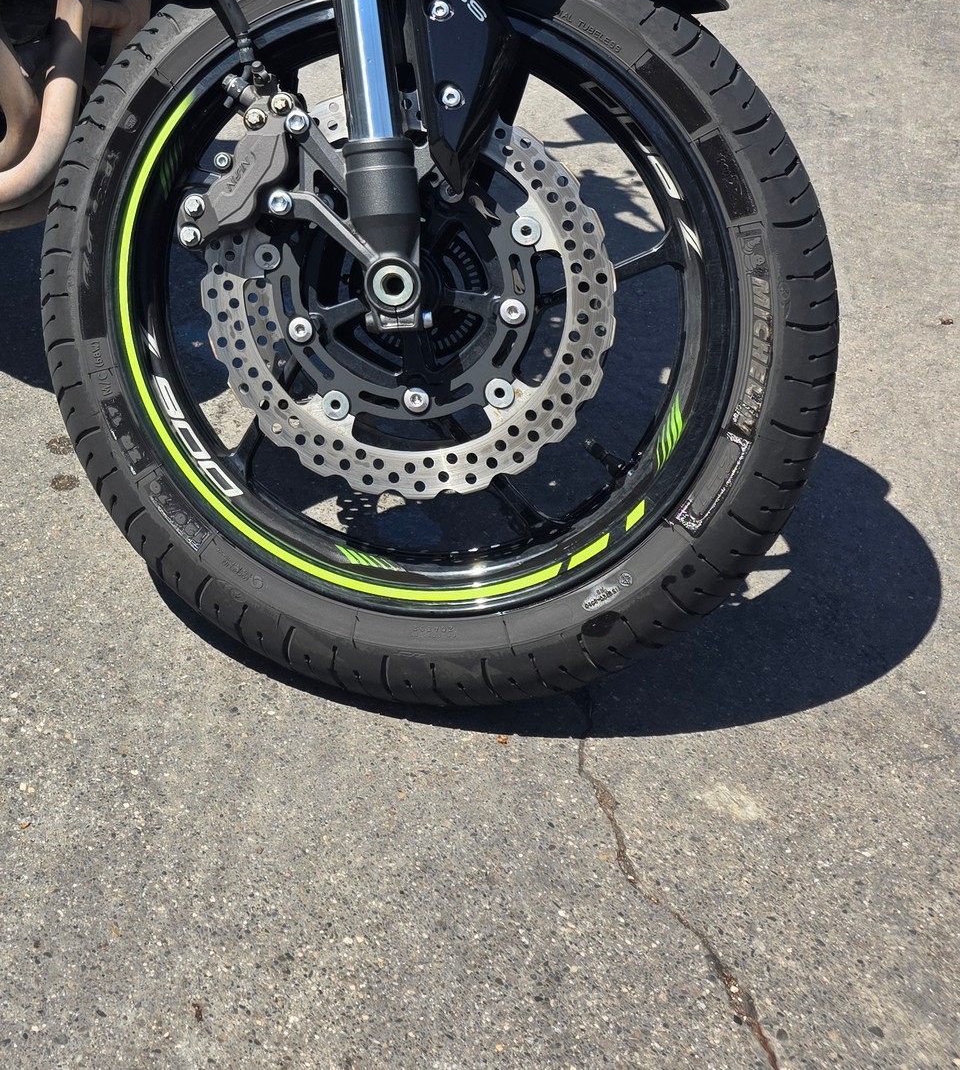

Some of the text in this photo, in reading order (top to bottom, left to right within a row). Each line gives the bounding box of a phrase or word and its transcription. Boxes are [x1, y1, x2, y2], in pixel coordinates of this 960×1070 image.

[577, 18, 622, 54] TUBELESS
[737, 276, 772, 436] MICHELIN
[152, 374, 244, 497] 900
